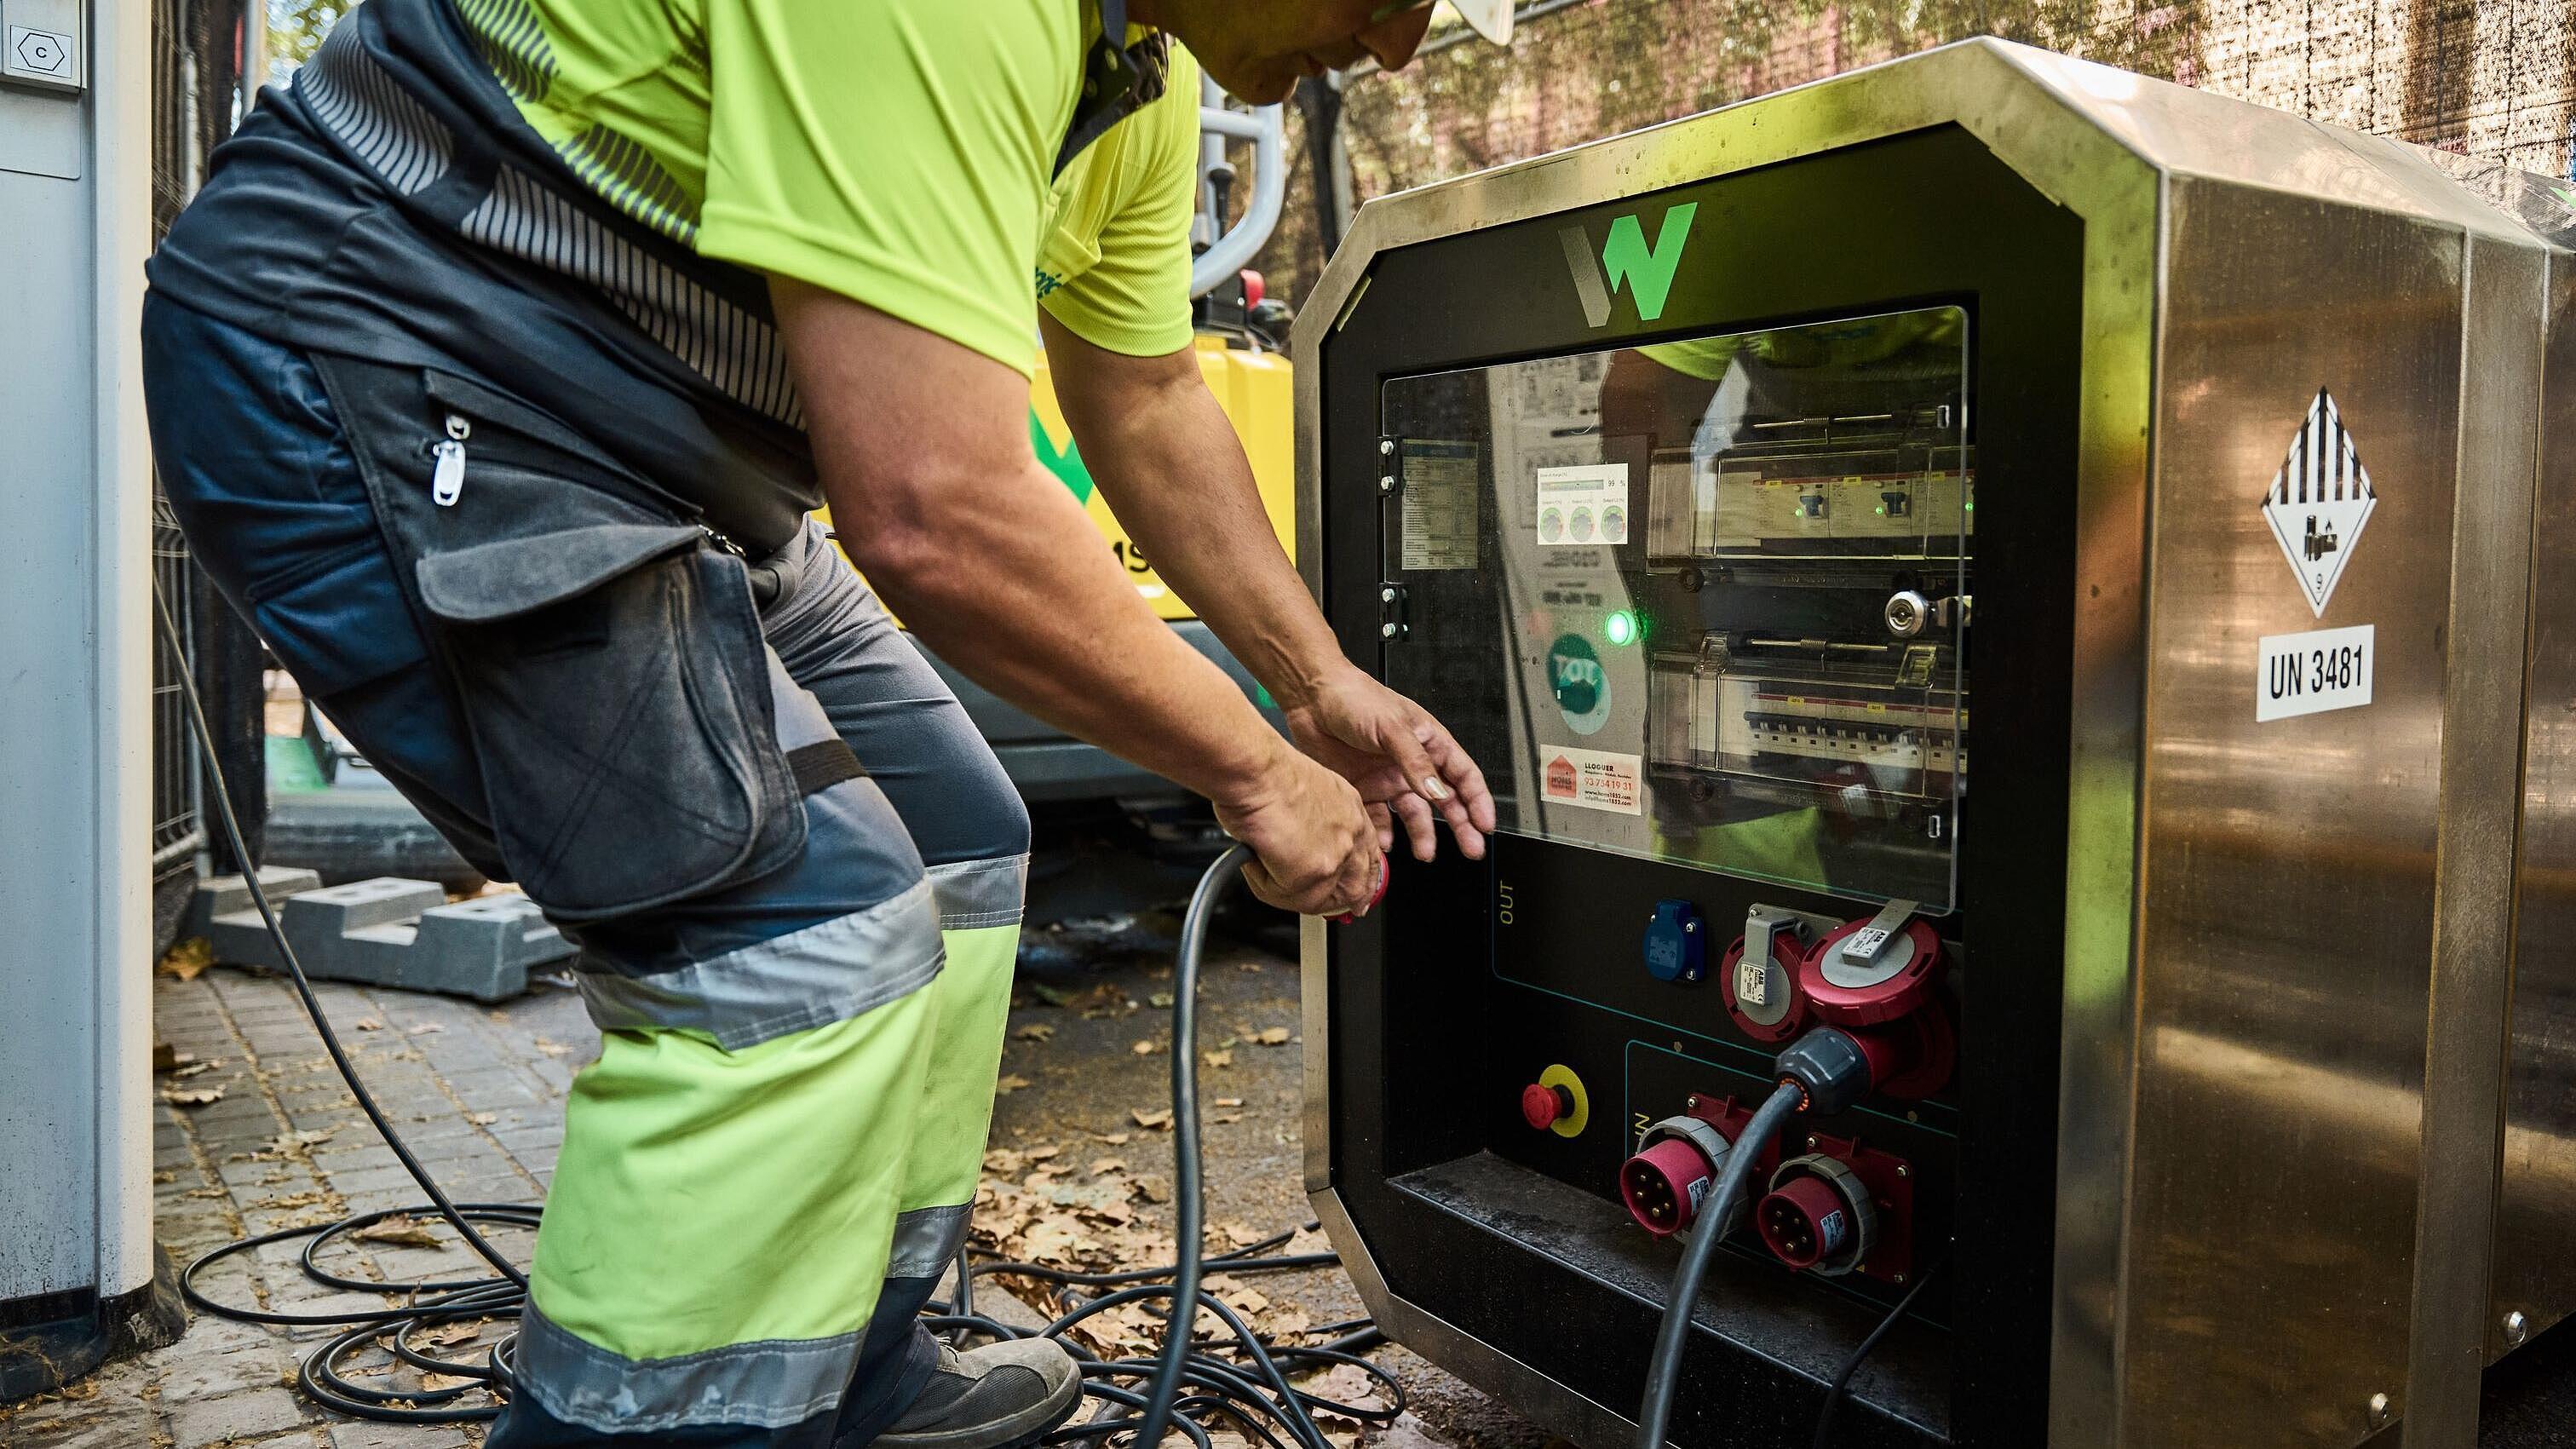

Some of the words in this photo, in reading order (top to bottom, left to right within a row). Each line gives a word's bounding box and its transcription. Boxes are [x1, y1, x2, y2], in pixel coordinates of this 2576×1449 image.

[35, 47, 47, 59] C
[2316, 573, 2323, 590] 9
[2271, 652, 2303, 699] UN
[2311, 645, 2362, 693] 3481
[1584, 762, 1614, 772] LLOGUER
[1499, 879, 1514, 925] OUT
